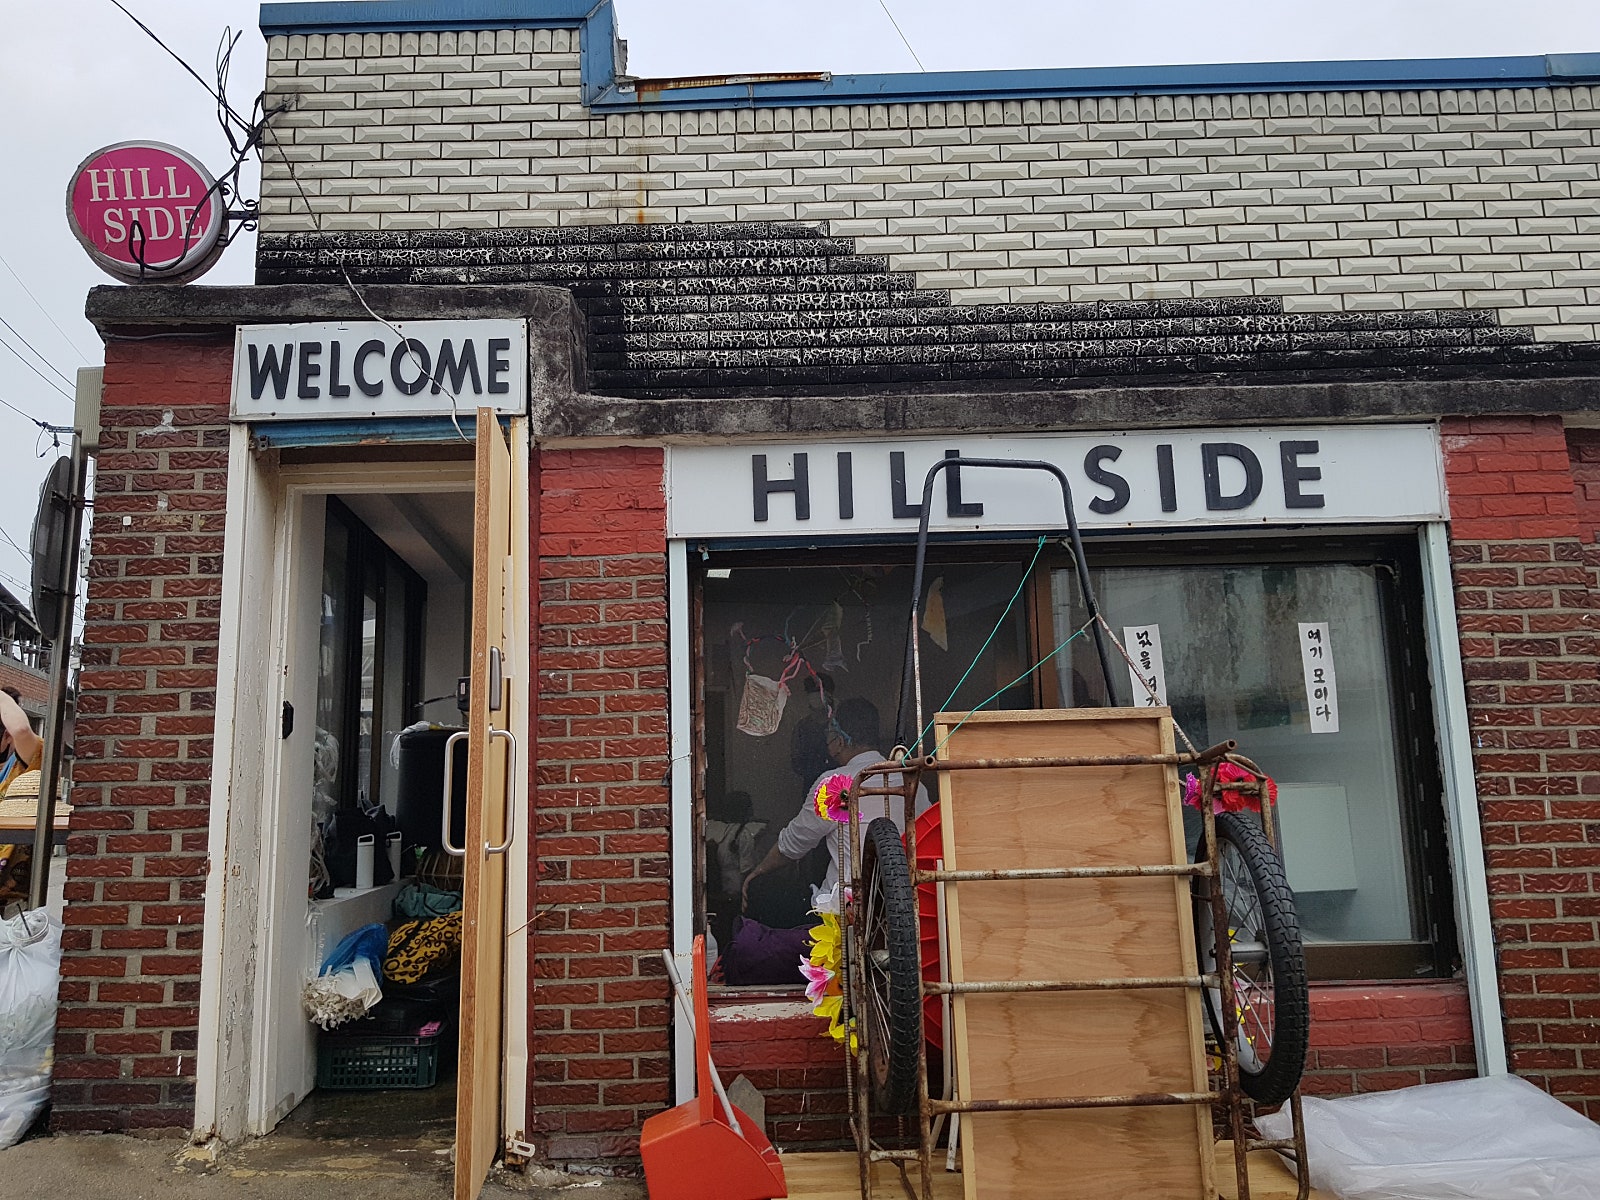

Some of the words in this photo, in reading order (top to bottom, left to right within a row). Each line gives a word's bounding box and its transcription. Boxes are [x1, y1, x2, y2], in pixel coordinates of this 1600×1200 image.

[87, 166, 191, 202] HILL
[103, 205, 204, 243] SIDE
[248, 338, 511, 400] WELCOME
[752, 449, 984, 522] HILL
[1084, 440, 1326, 515] SIDE
[1307, 628, 1323, 660] 여기
[1312, 668, 1332, 722] 모이다
